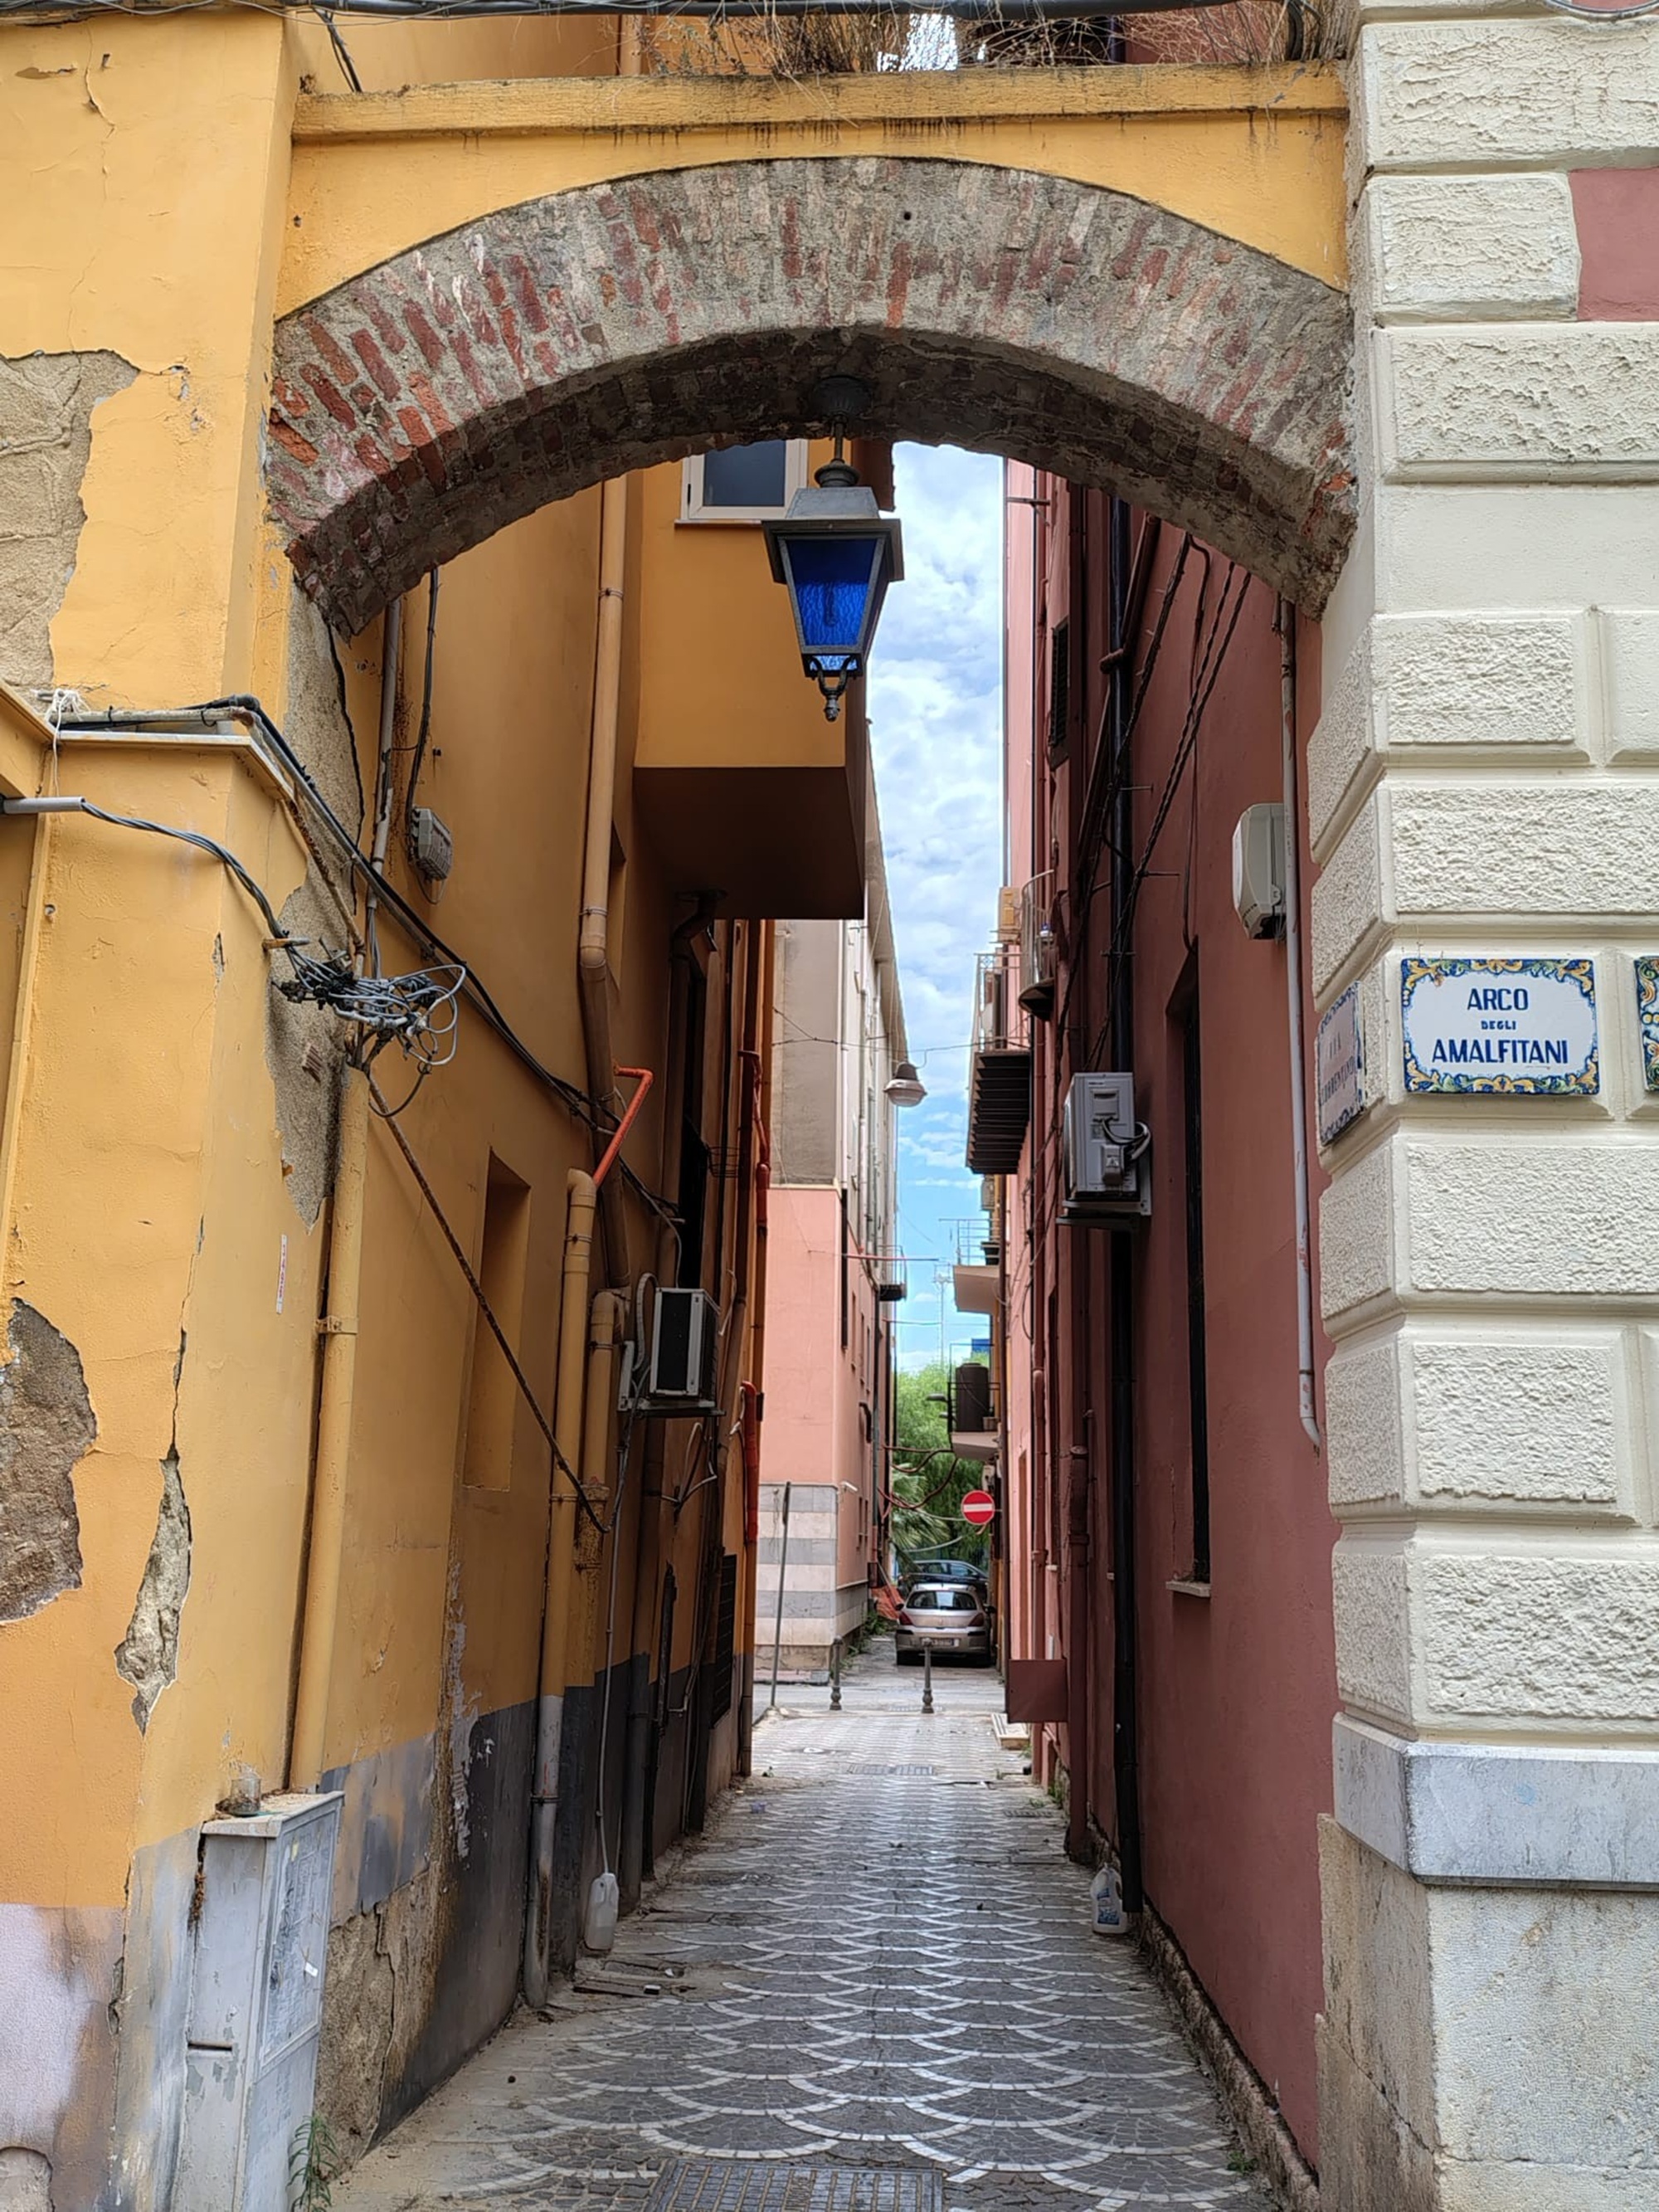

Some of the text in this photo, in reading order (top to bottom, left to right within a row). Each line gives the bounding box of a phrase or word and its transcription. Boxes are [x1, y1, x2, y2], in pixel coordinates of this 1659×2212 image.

[1467, 987, 1529, 1011] ARCO
[1481, 1020, 1517, 1030] DEGLI
[1432, 1039, 1568, 1064] AMALFITANI
